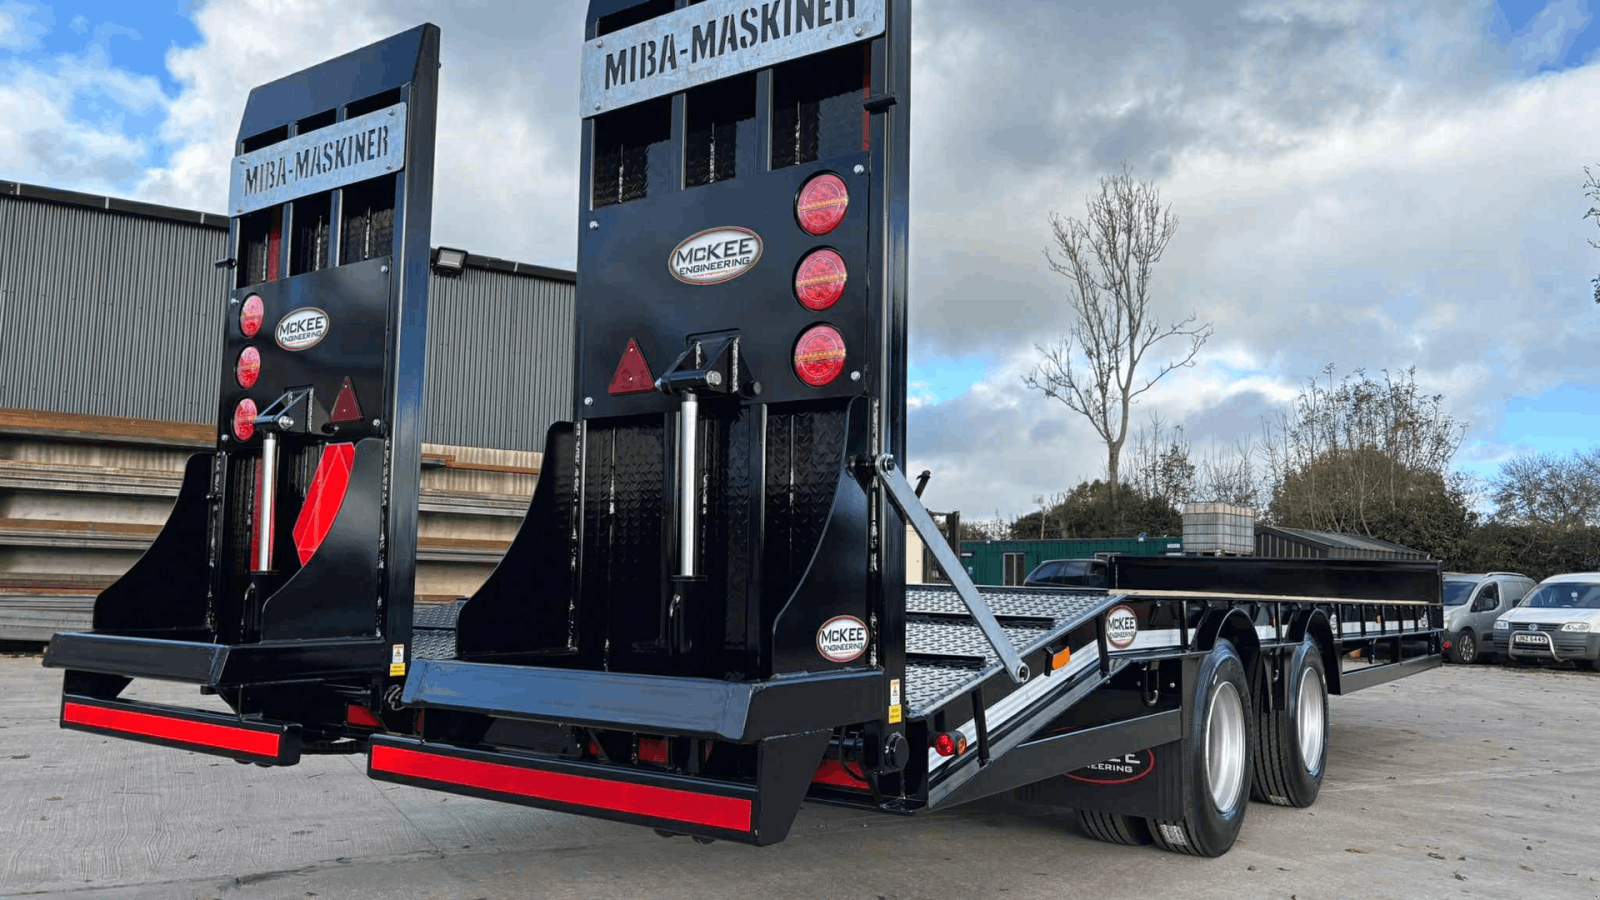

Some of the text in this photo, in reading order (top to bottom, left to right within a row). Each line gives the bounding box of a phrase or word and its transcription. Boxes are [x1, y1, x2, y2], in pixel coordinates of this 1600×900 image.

[244, 125, 389, 197] MIBA-MASKINER
[679, 256, 751, 276] ENGINEERING
[281, 330, 322, 343] ENGINEERING
[823, 642, 864, 652] ENGINEERING
